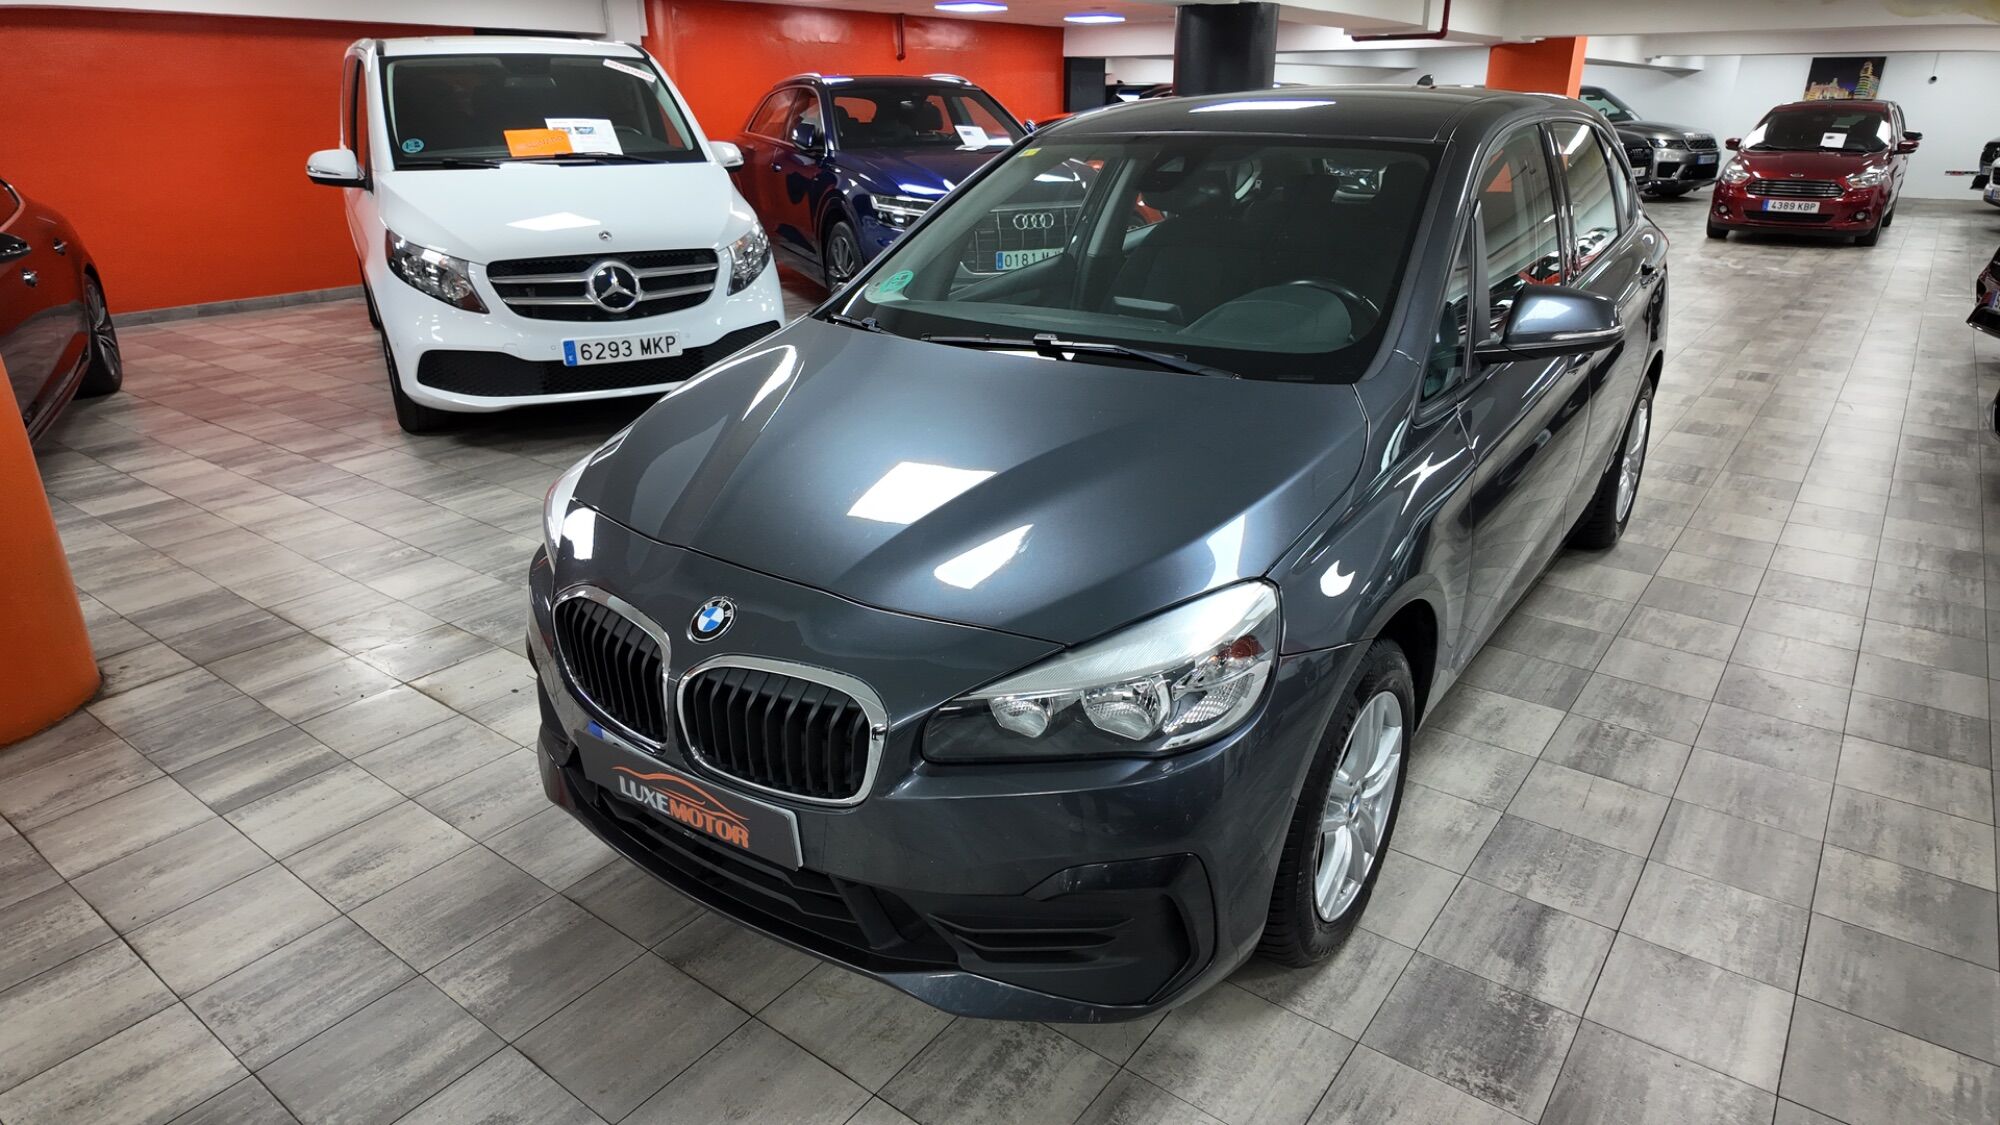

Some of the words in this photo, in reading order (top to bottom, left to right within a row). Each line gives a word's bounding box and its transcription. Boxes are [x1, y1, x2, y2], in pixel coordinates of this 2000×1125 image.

[1771, 201, 1796, 210] 4389
[1797, 202, 1817, 211] KBP
[1004, 253, 1036, 268] 0181
[580, 340, 633, 361] 6293
[640, 335, 676, 356] MKP
[618, 775, 749, 849] LUXEMOTOR
